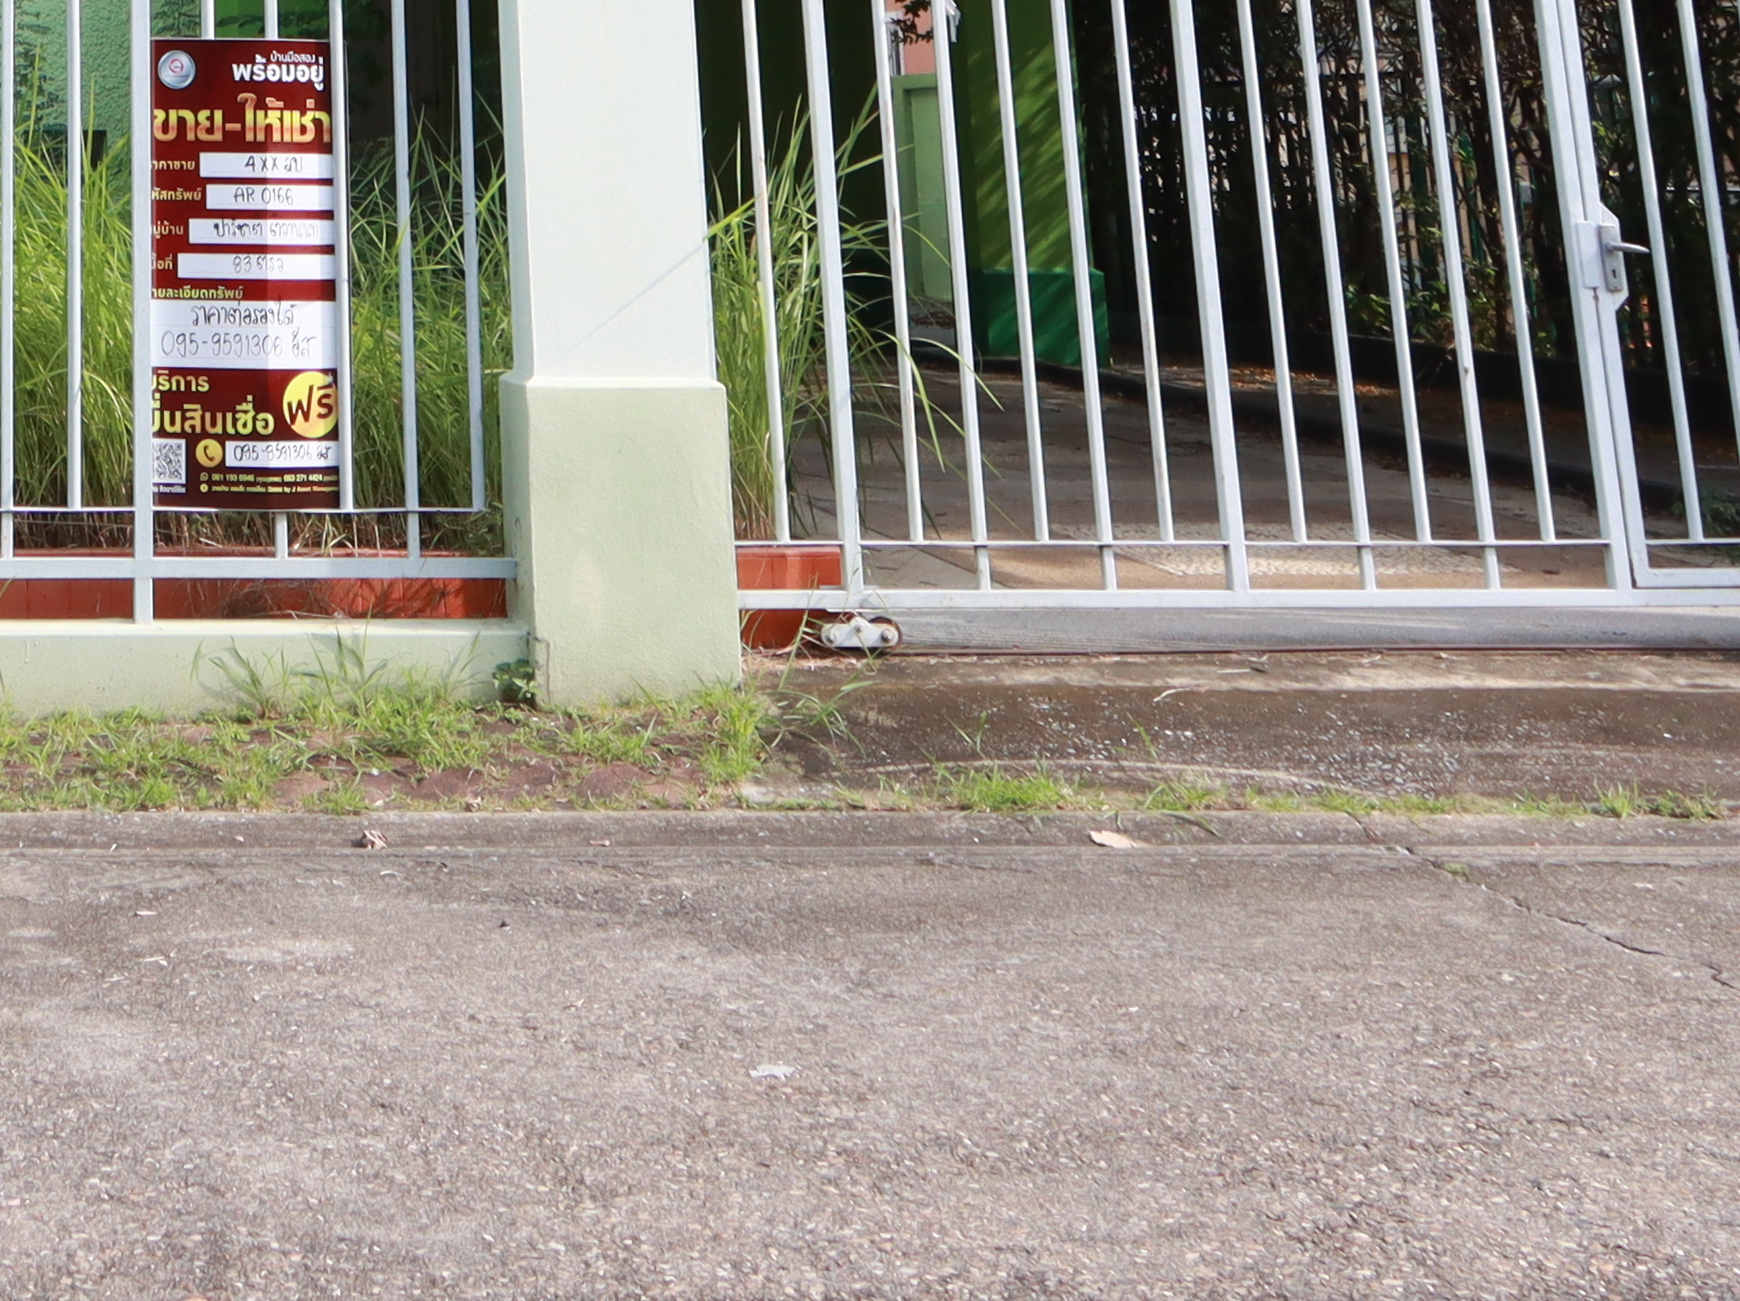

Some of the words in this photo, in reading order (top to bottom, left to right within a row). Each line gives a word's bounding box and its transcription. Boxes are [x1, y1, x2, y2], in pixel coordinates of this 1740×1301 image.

[270, 50, 316, 63] บ้านมือสอง
[232, 53, 324, 91] พร้อมอยู่
[152, 91, 332, 144] ขาย-ให้เช่า
[234, 187, 255, 204] AR
[261, 187, 294, 205] 0166
[233, 255, 252, 273] 83
[160, 329, 283, 359] 095-9591306
